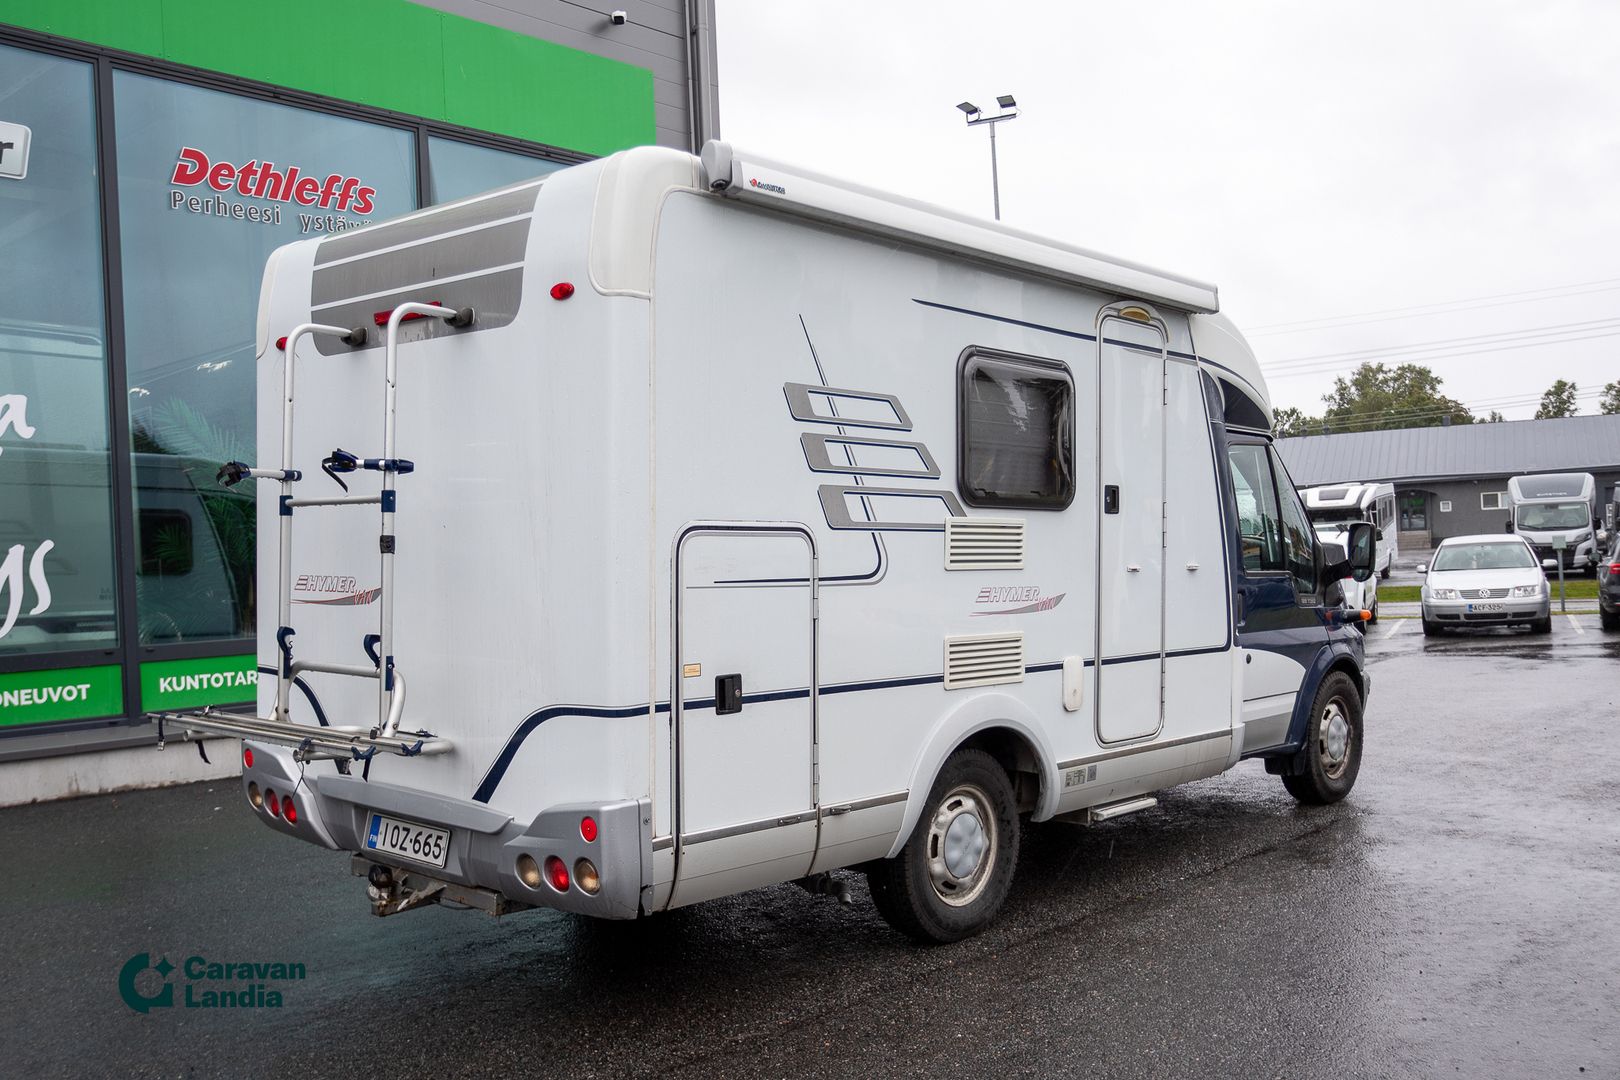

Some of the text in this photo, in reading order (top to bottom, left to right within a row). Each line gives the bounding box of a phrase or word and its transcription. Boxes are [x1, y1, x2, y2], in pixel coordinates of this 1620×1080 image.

[171, 146, 376, 215] Dethleffs
[170, 190, 281, 224] Perheesi
[305, 574, 357, 593] HYMER
[989, 585, 1041, 603] HYMER
[0, 683, 91, 708] NEUVOT
[382, 822, 444, 860] IOZ-665
